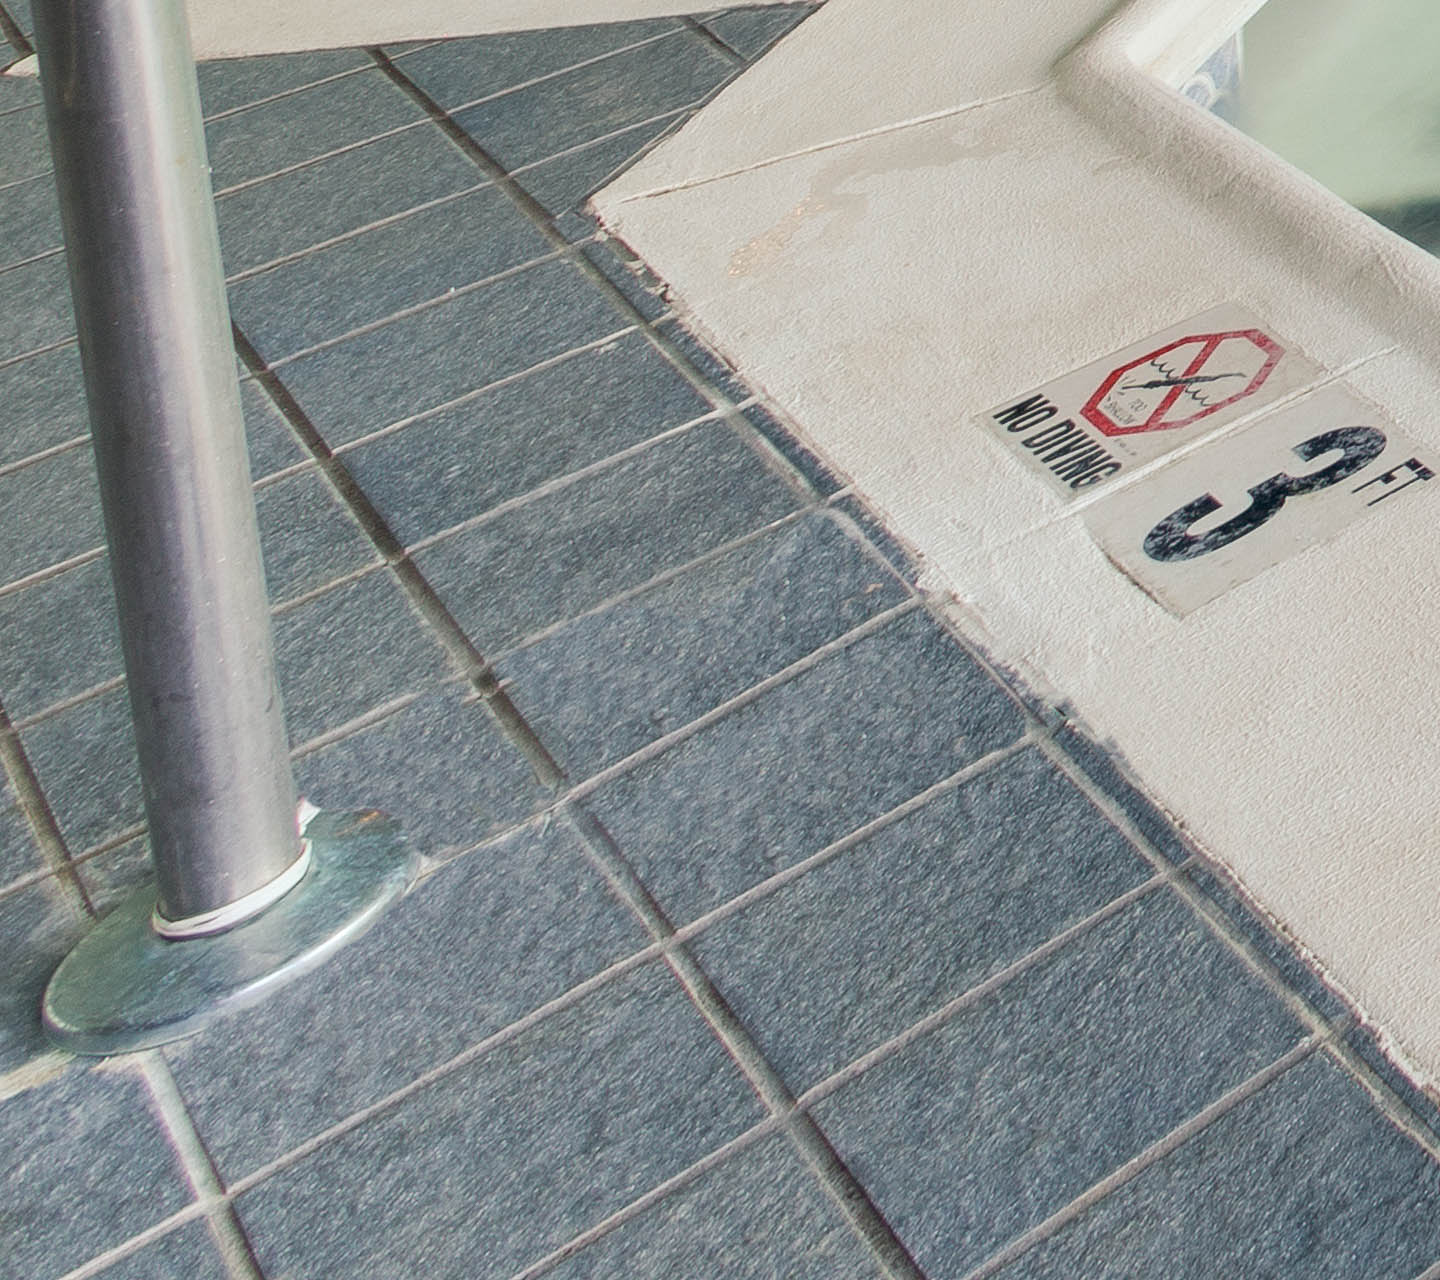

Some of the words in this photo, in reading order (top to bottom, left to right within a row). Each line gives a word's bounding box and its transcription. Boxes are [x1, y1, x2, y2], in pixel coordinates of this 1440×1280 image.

[994, 393, 1058, 433] NO
[1021, 418, 1124, 489] DIVING
[1143, 425, 1387, 563] 3
[1351, 458, 1437, 507] FT
